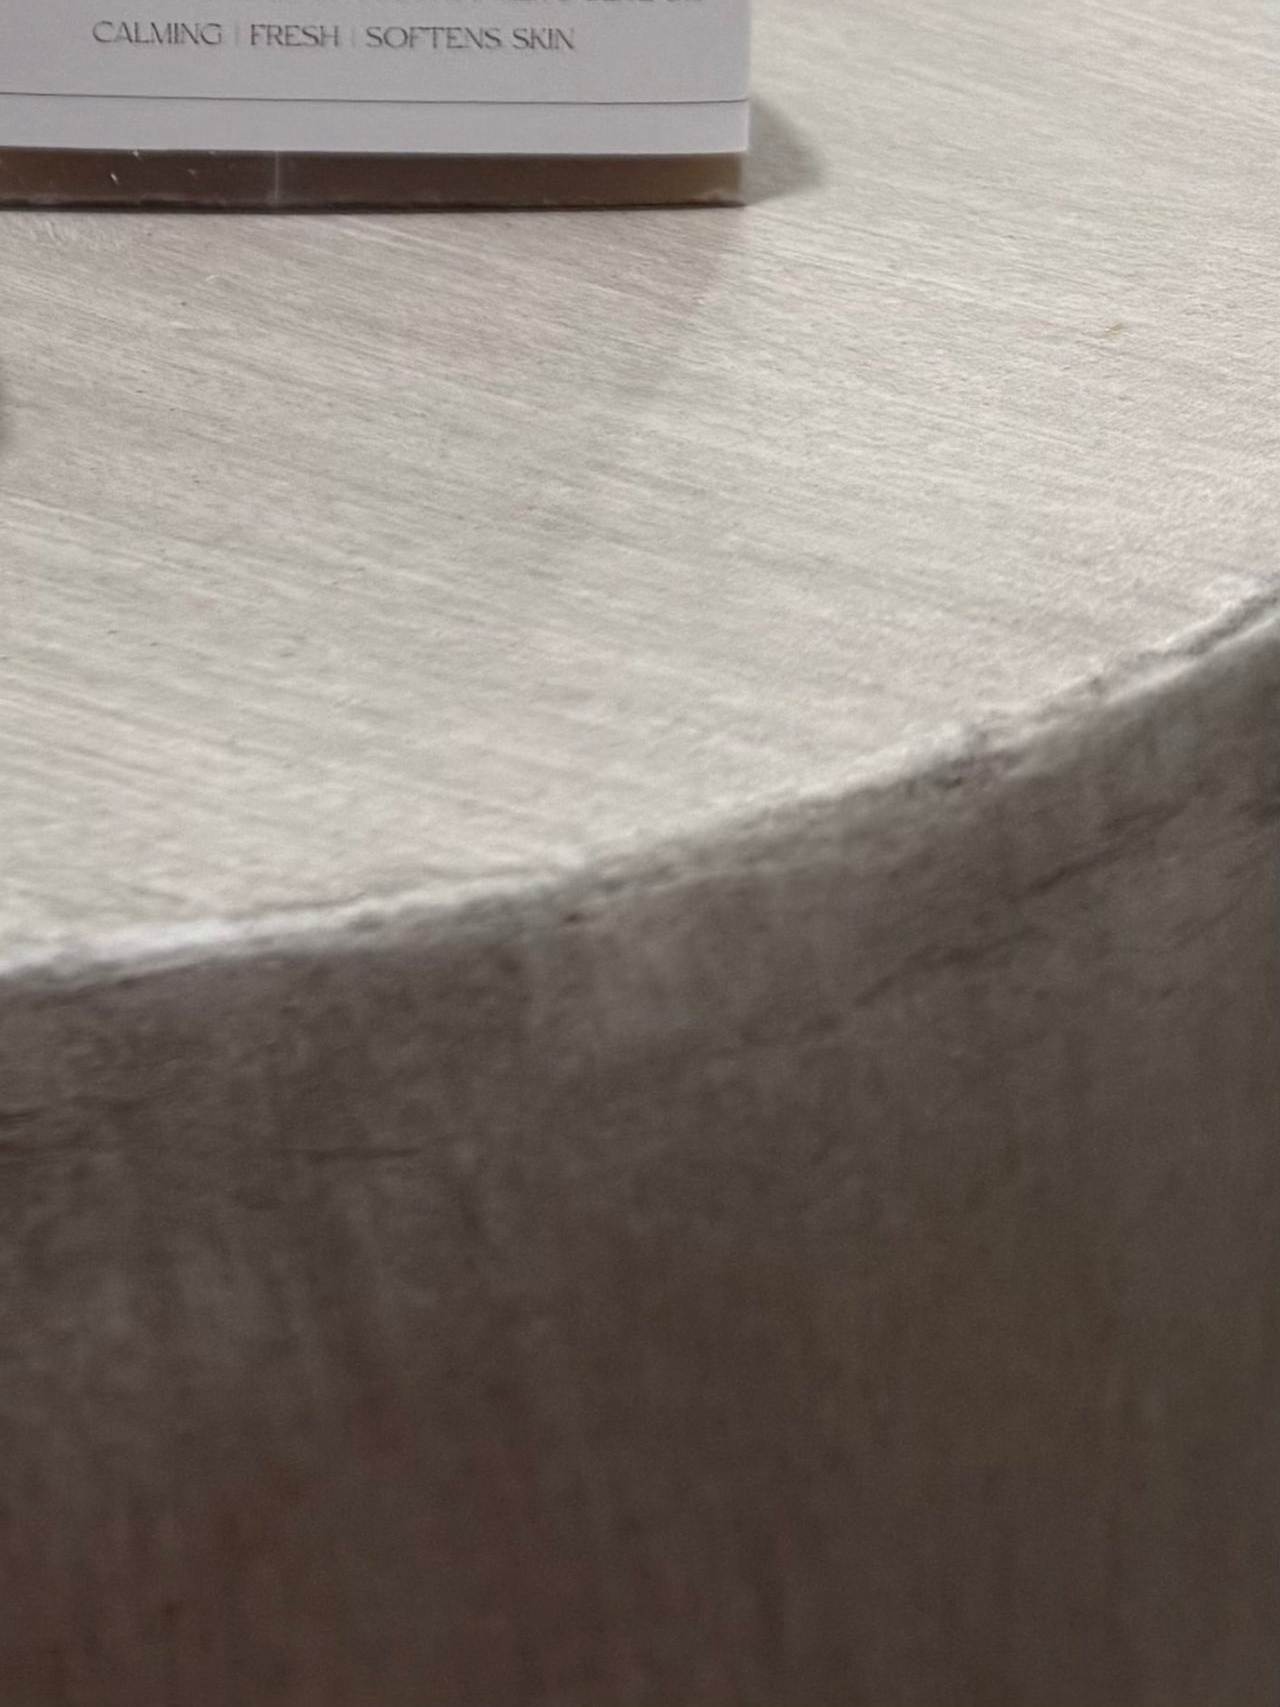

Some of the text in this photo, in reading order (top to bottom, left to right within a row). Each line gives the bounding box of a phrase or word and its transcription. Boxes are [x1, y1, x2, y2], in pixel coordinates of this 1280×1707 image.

[91, 20, 575, 51] CALMING FRESH SOFTENS SKIN
